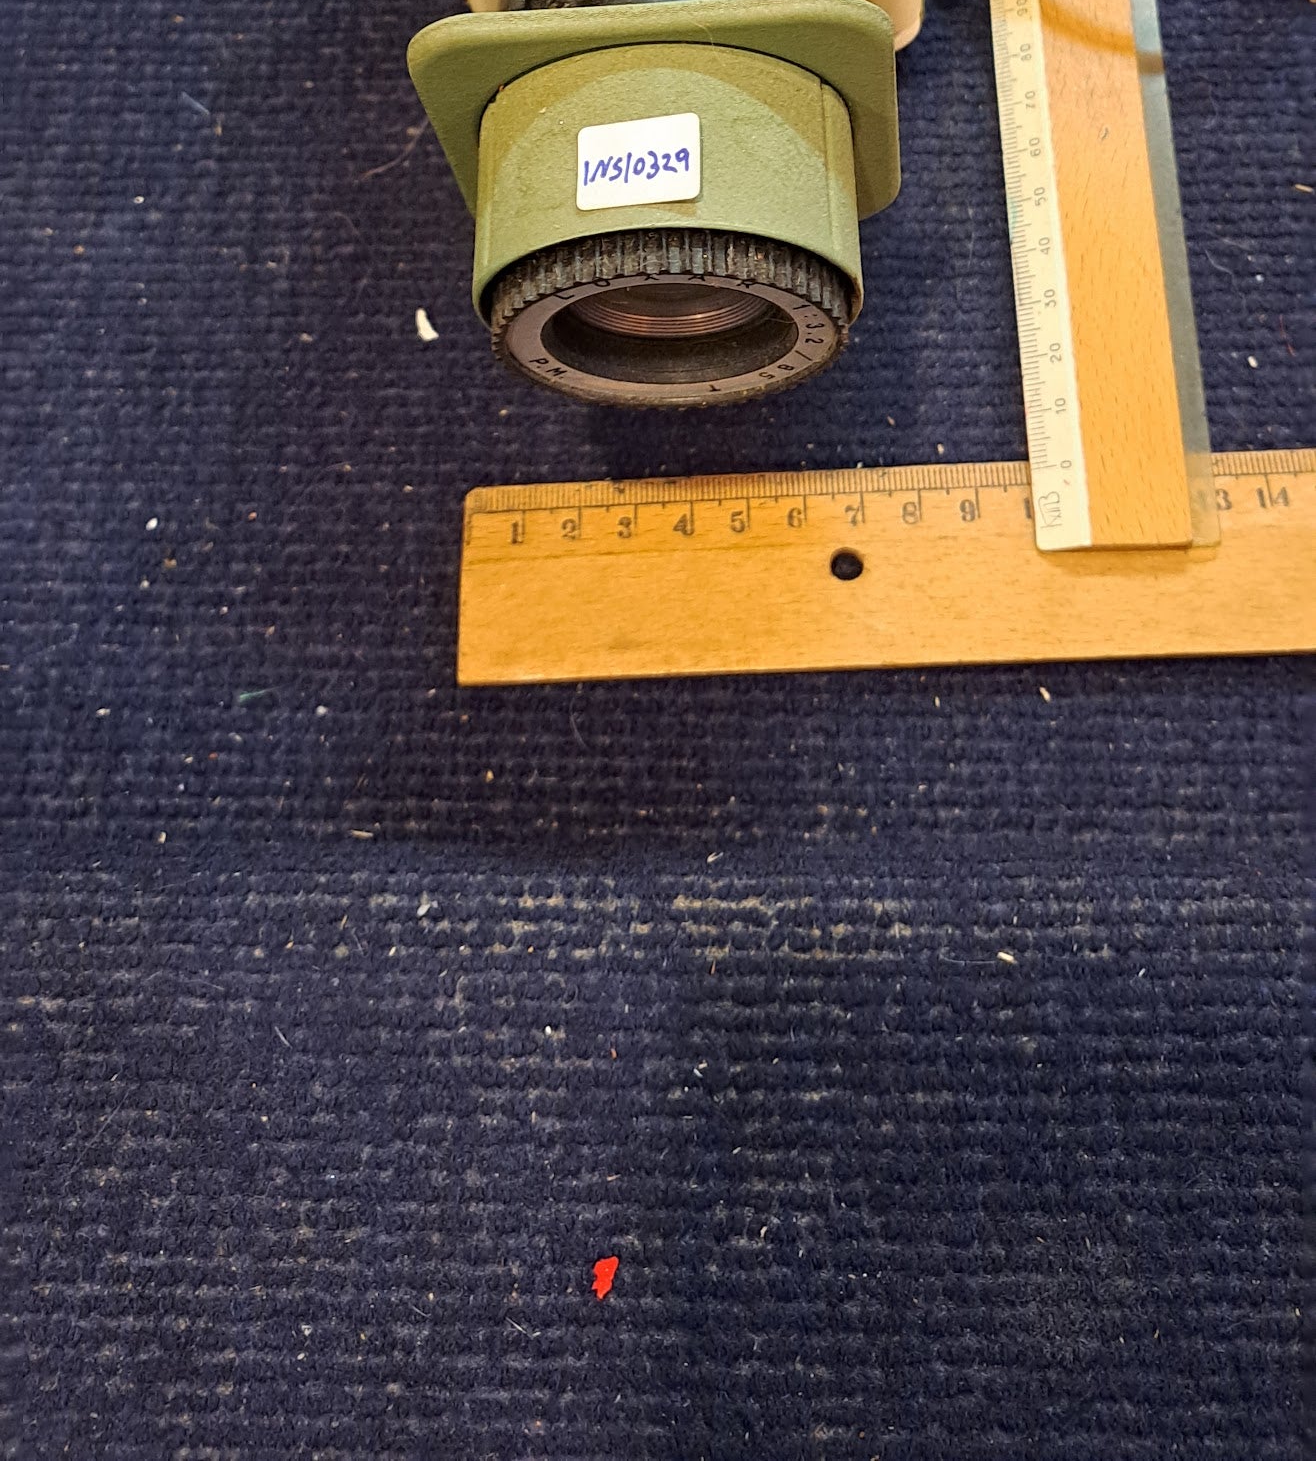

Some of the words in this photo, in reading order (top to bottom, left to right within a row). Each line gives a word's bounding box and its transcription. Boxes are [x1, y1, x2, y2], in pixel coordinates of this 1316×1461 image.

[1020, 43, 1032, 62] 80
[1025, 91, 1036, 110] 70
[1029, 138, 1042, 158] 60
[1034, 187, 1047, 207] 50
[1038, 237, 1050, 255] 40
[1044, 289, 1057, 308] 30
[1050, 342, 1062, 363] 20
[1055, 397, 1067, 415] 10
[1060, 459, 1072, 470] 0
[1256, 486, 1289, 509] 14
[510, 521, 524, 544] 1
[561, 518, 577, 539] 2
[616, 516, 632, 538] 3
[673, 514, 695, 536] 4
[730, 510, 746, 534] 5
[787, 507, 802, 528] 6
[845, 504, 861, 526] 7
[902, 501, 919, 525] 8
[959, 499, 976, 522] 9
